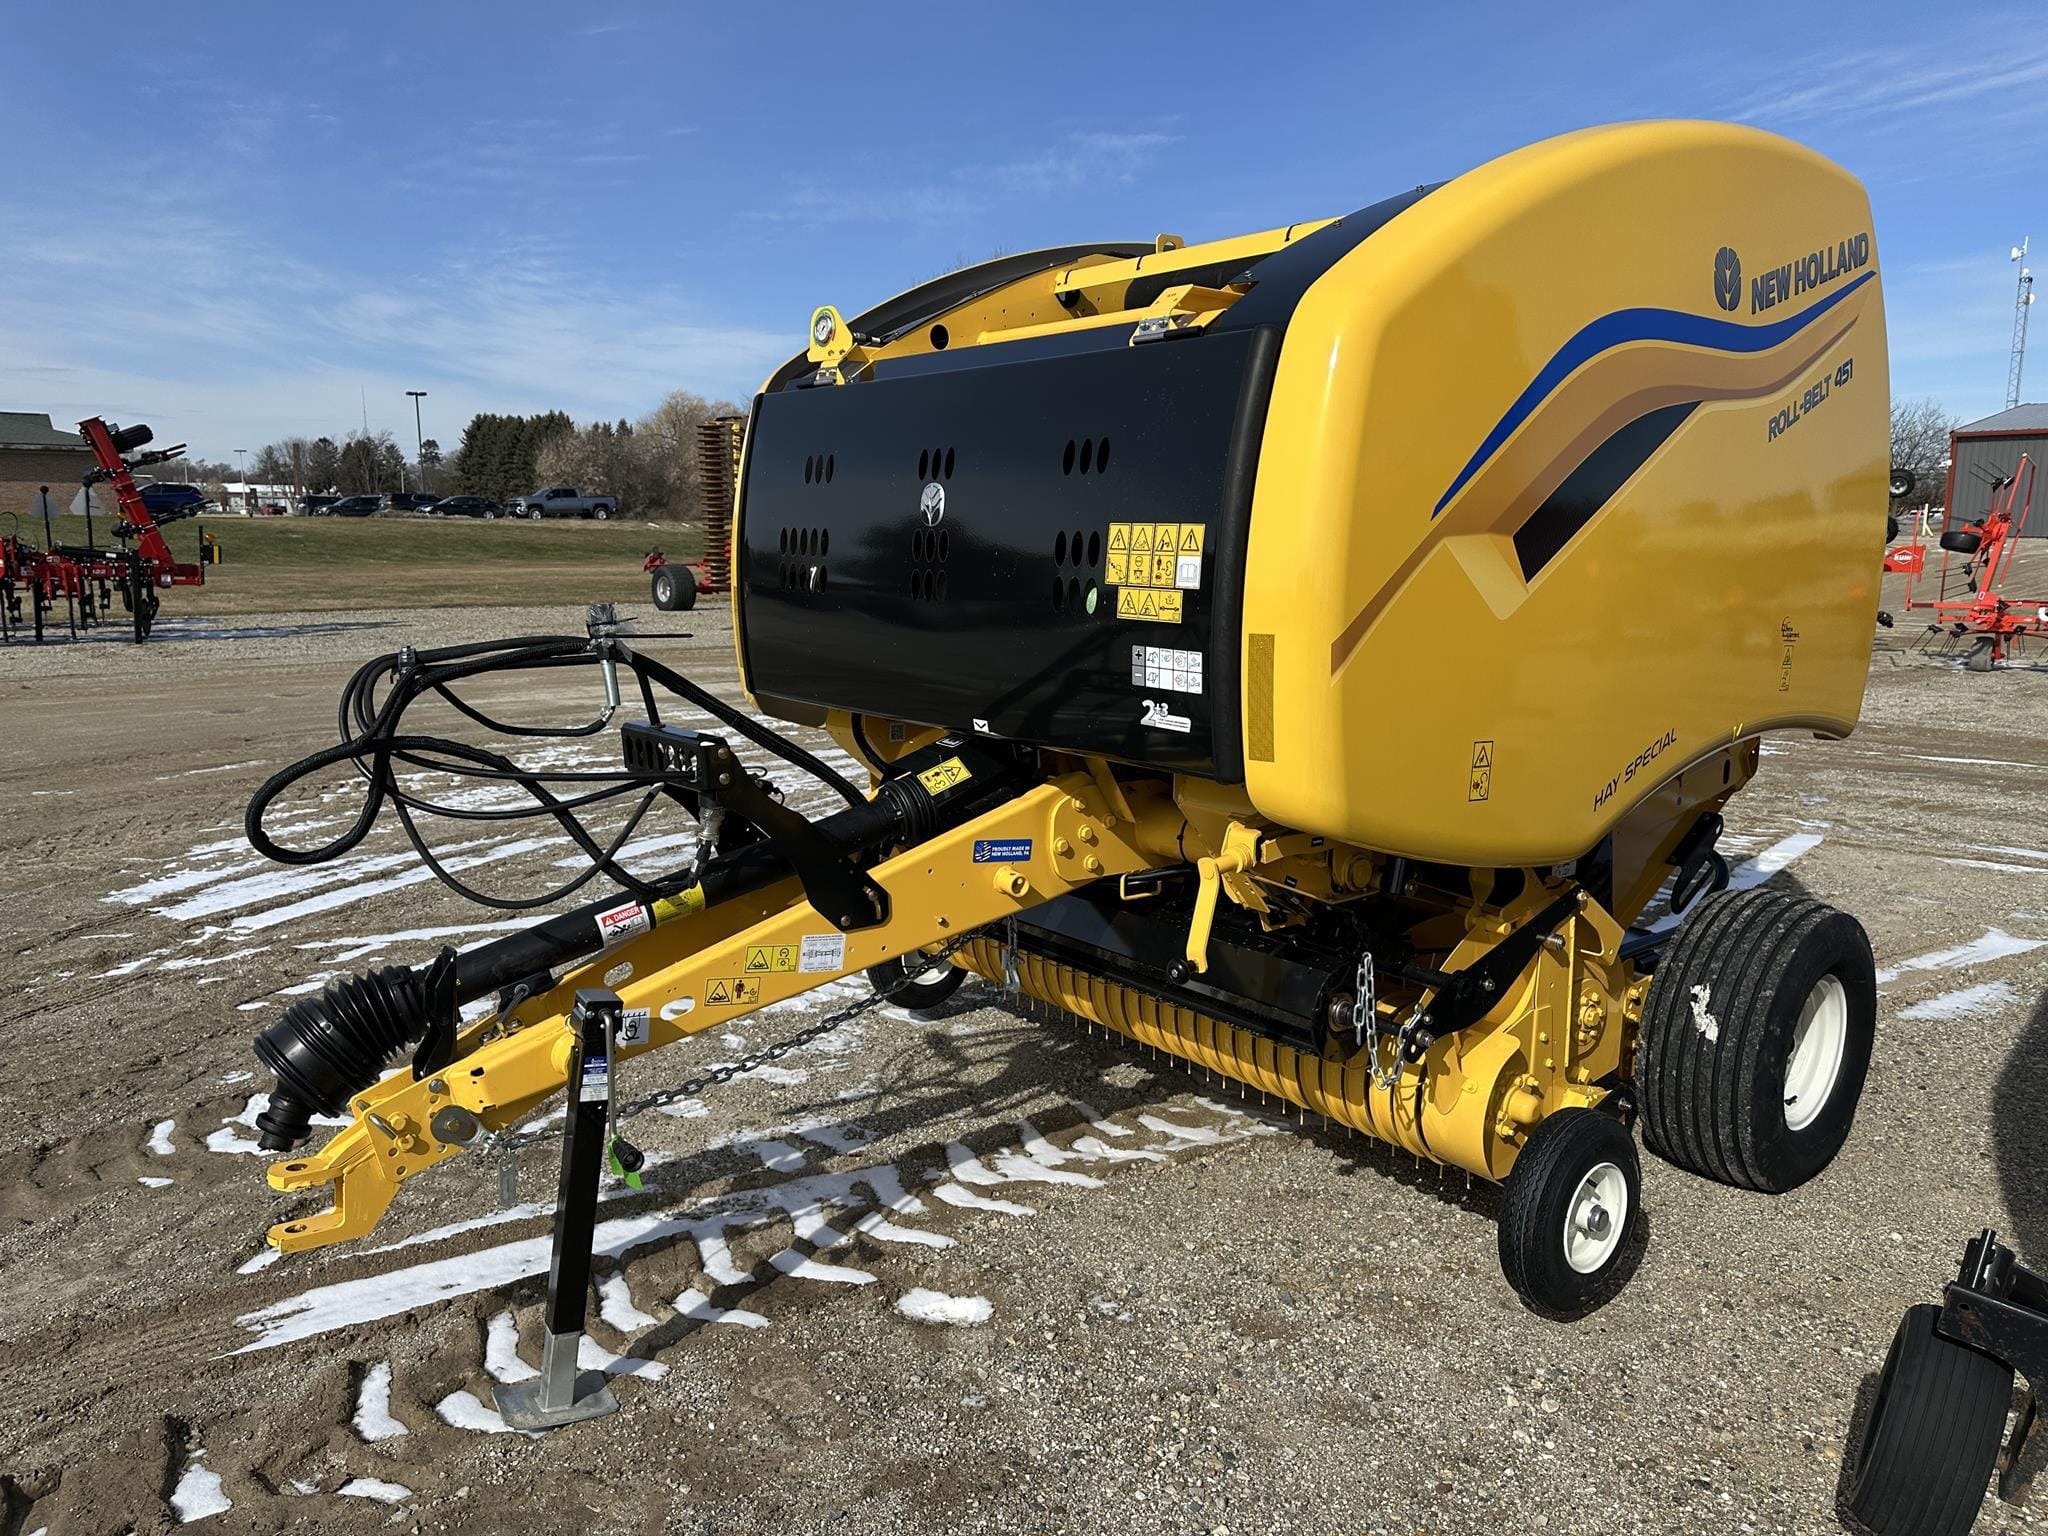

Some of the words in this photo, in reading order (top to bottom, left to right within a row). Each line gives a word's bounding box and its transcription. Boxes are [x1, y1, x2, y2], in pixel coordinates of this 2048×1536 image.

[1751, 263, 1792, 315] NEW
[1794, 232, 1869, 296] HOLLAND
[1768, 373, 1832, 443] ROLL-BELT
[1834, 357, 1853, 388] 451
[1593, 773, 1621, 812] HAY
[1624, 727, 1677, 783] SPECIAL
[613, 906, 640, 921] DANGER
